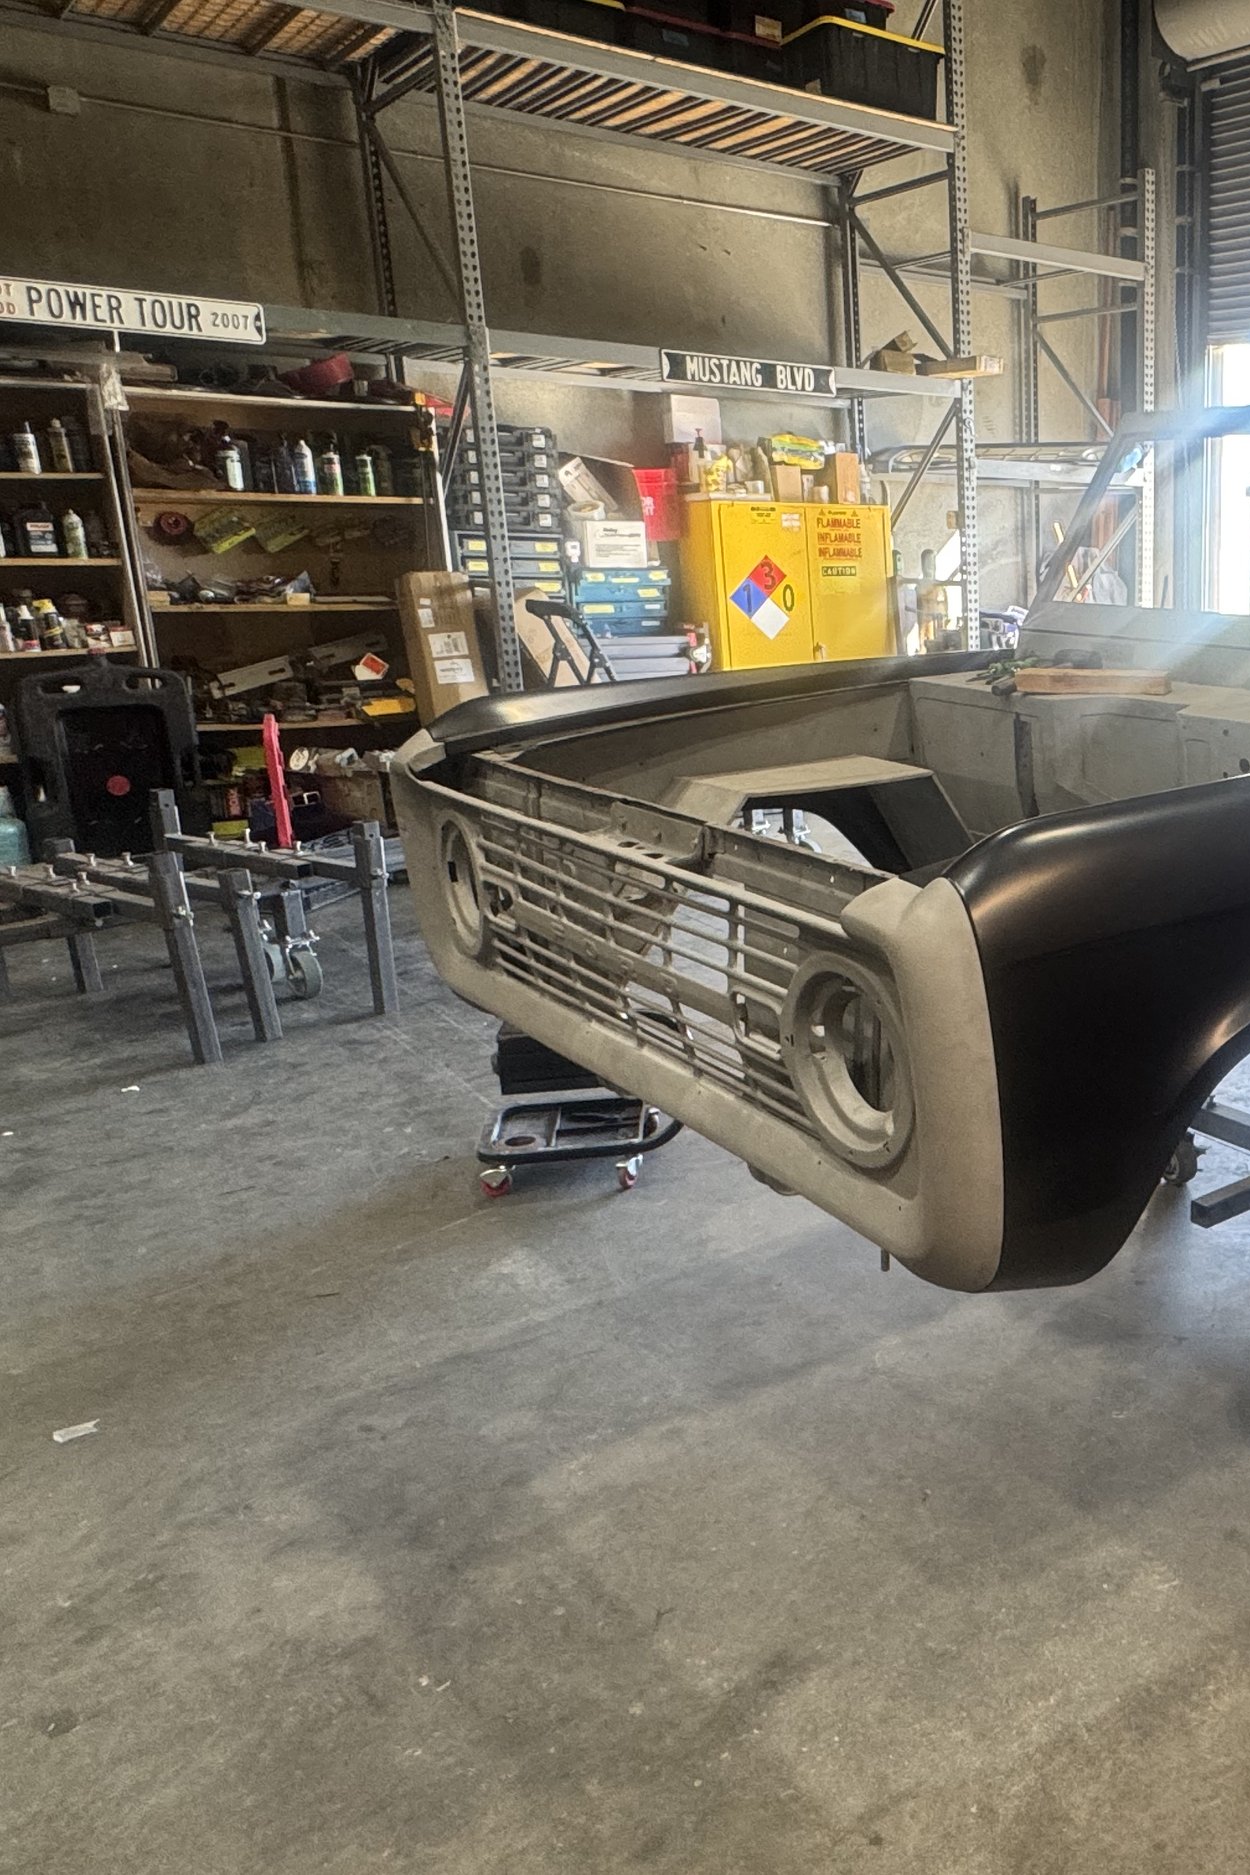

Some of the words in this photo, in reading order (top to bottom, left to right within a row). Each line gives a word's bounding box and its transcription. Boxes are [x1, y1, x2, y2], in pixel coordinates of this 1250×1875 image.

[26, 286, 124, 324] POWER
[133, 297, 203, 332] TOUR
[209, 312, 250, 331] 2007
[685, 355, 763, 387] MUSTANG
[776, 364, 815, 391] BLVD
[817, 517, 861, 529] FLAMMABLE
[760, 561, 776, 590] 3
[822, 566, 856, 576] CAUTION
[743, 584, 752, 613] 1
[782, 584, 795, 612] 0
